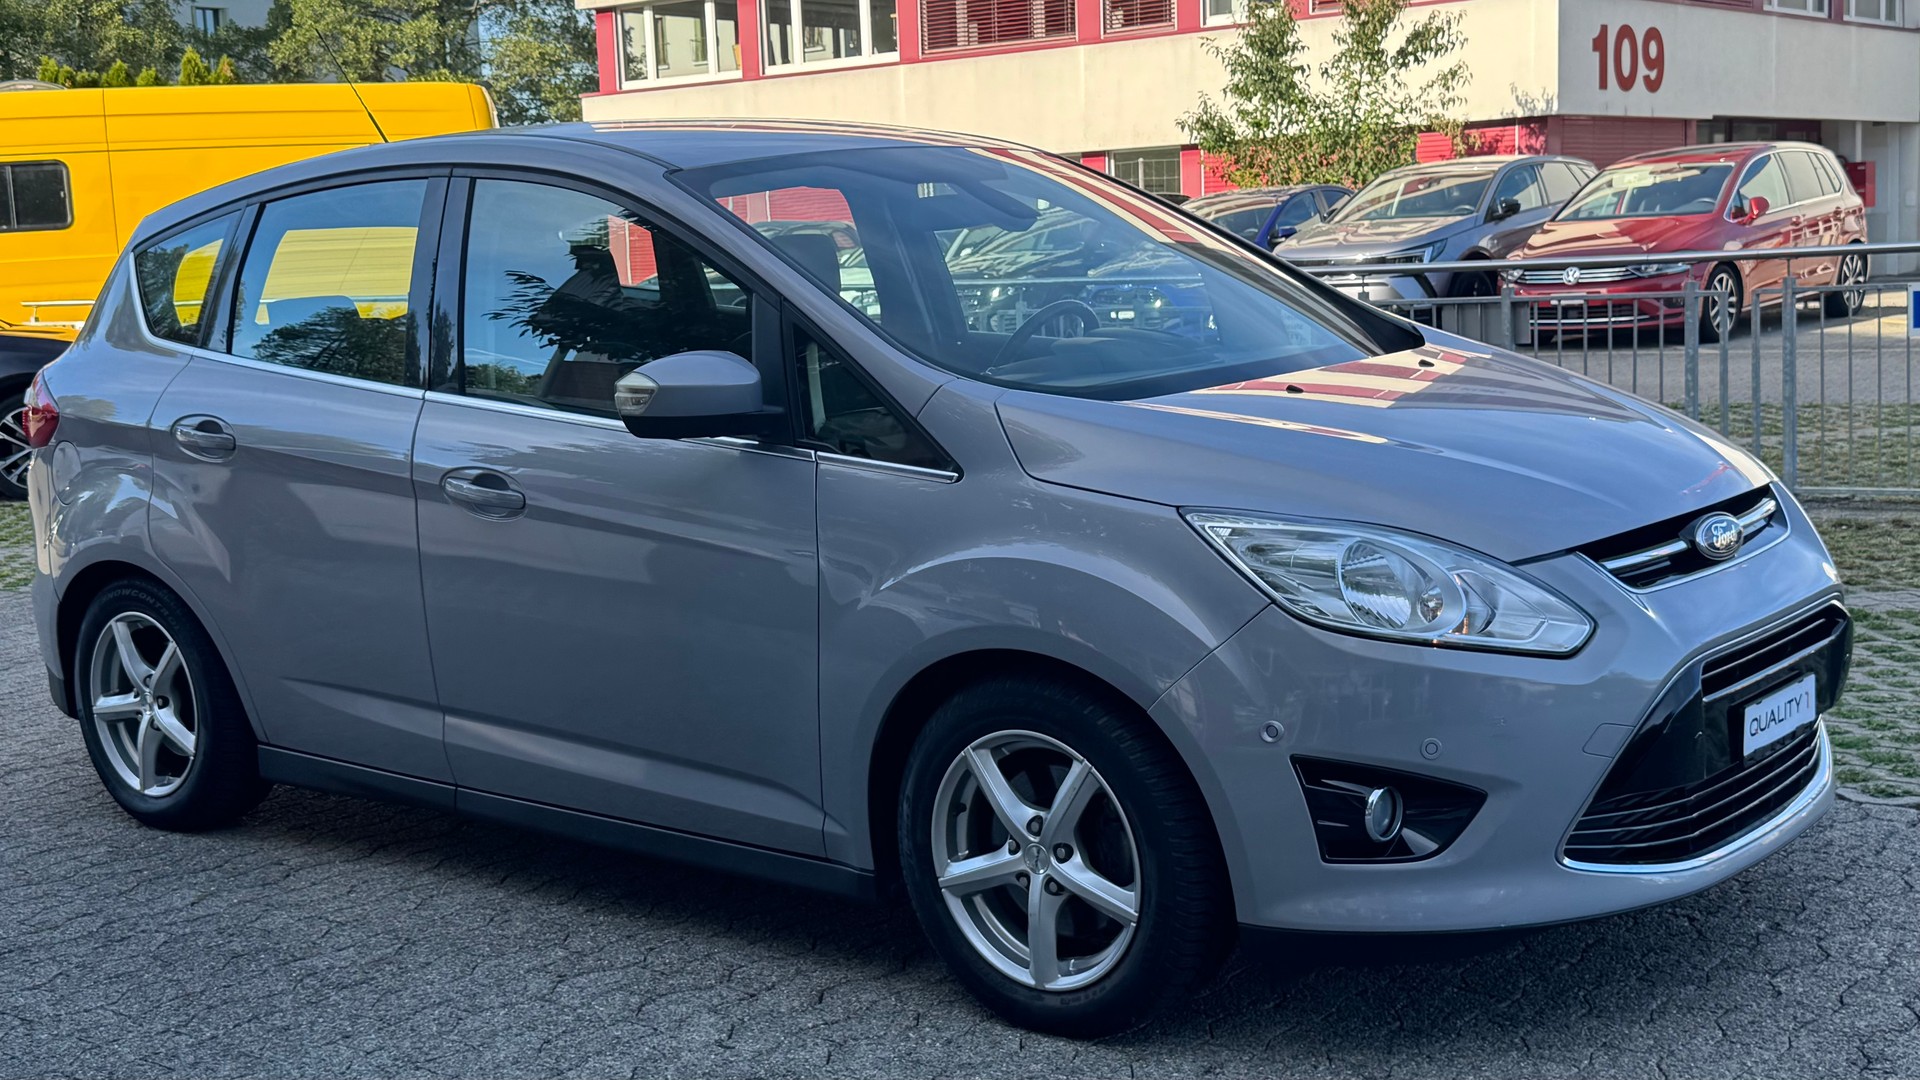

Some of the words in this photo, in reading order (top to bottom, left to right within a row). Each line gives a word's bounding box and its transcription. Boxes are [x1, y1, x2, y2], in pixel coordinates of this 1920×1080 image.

[1592, 23, 1665, 94] 109
[1711, 521, 1739, 549] Ford
[1749, 693, 1803, 737] QUALITY
[1804, 691, 1810, 709] 1
